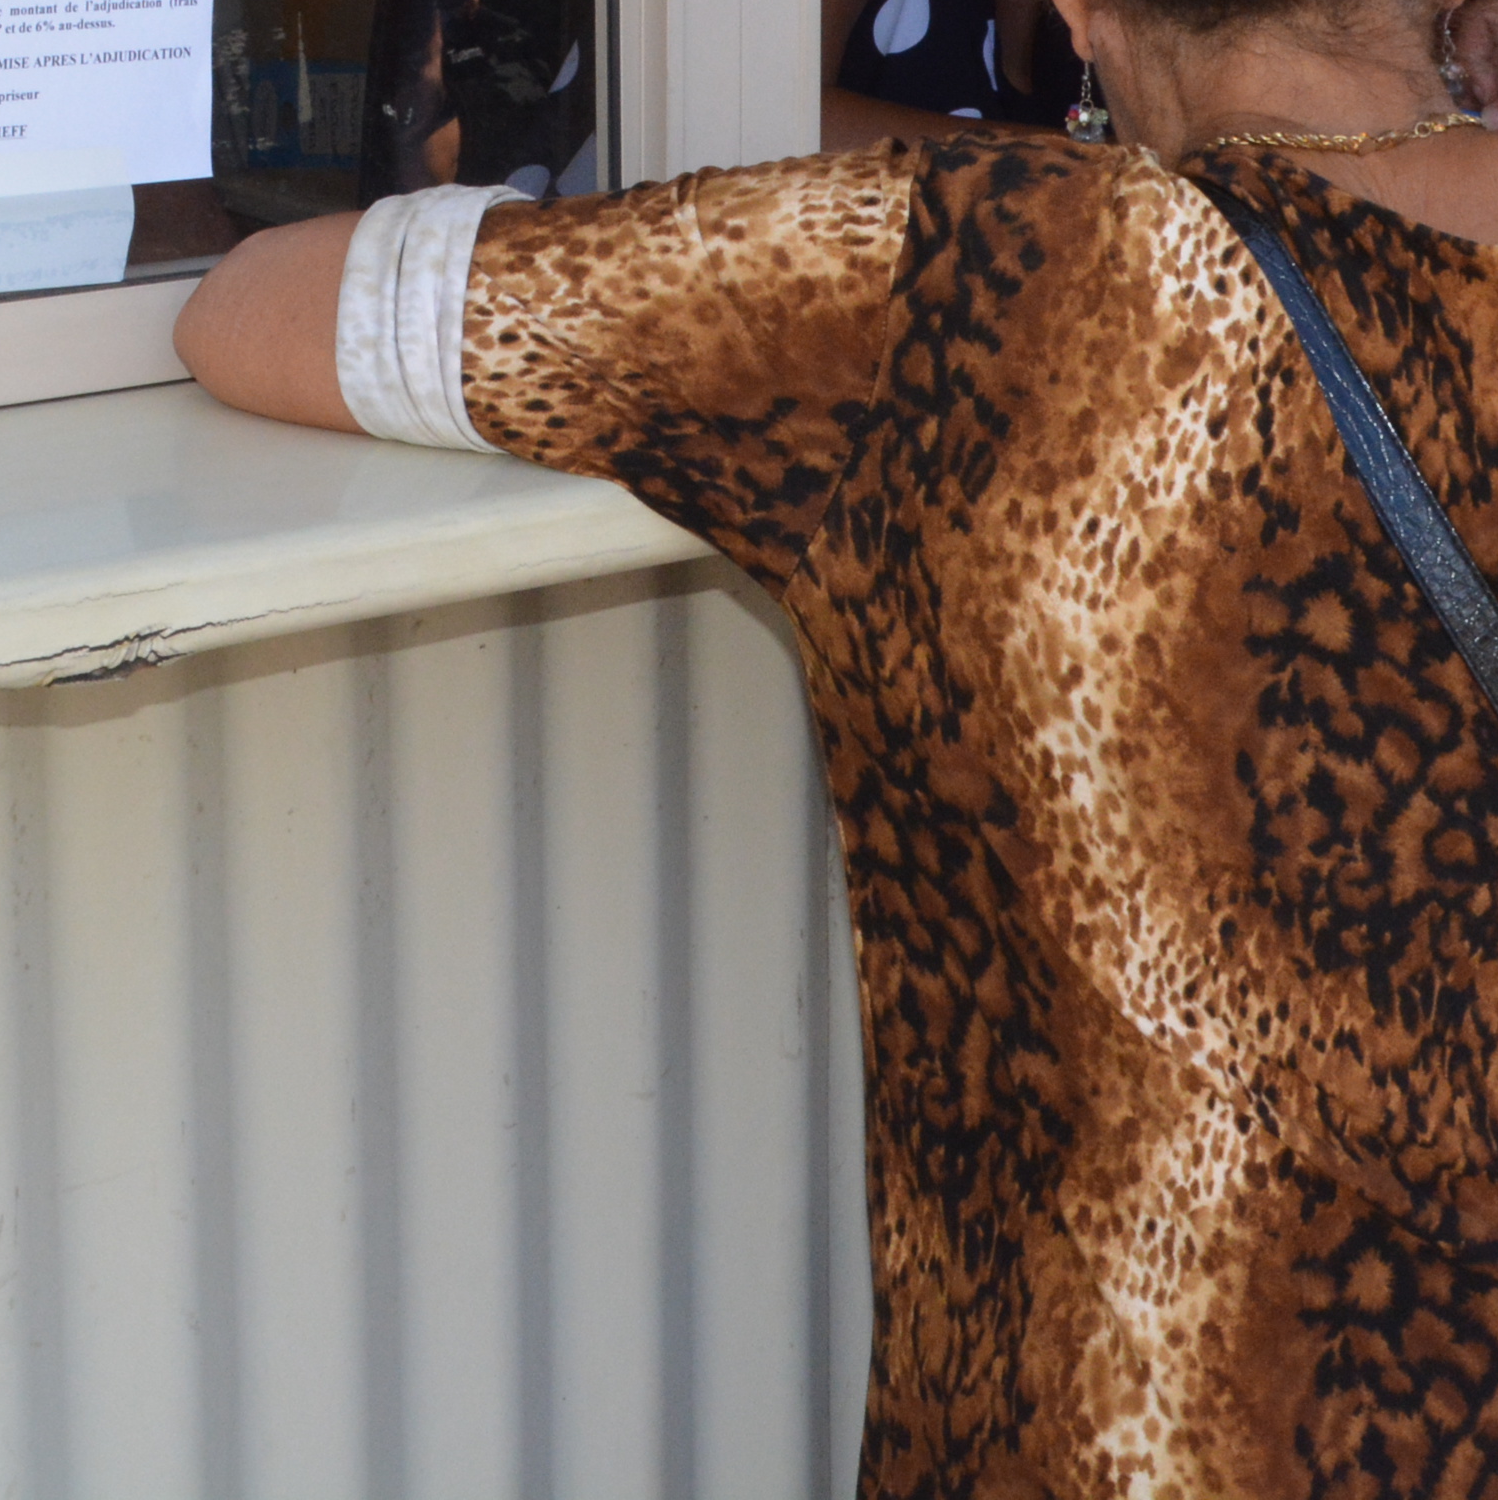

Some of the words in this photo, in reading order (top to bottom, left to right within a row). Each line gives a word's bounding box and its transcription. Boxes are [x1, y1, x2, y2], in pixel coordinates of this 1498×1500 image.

[9, 4, 58, 16] montant
[35, 20, 55, 32] 6%
[33, 54, 77, 68] APRES
